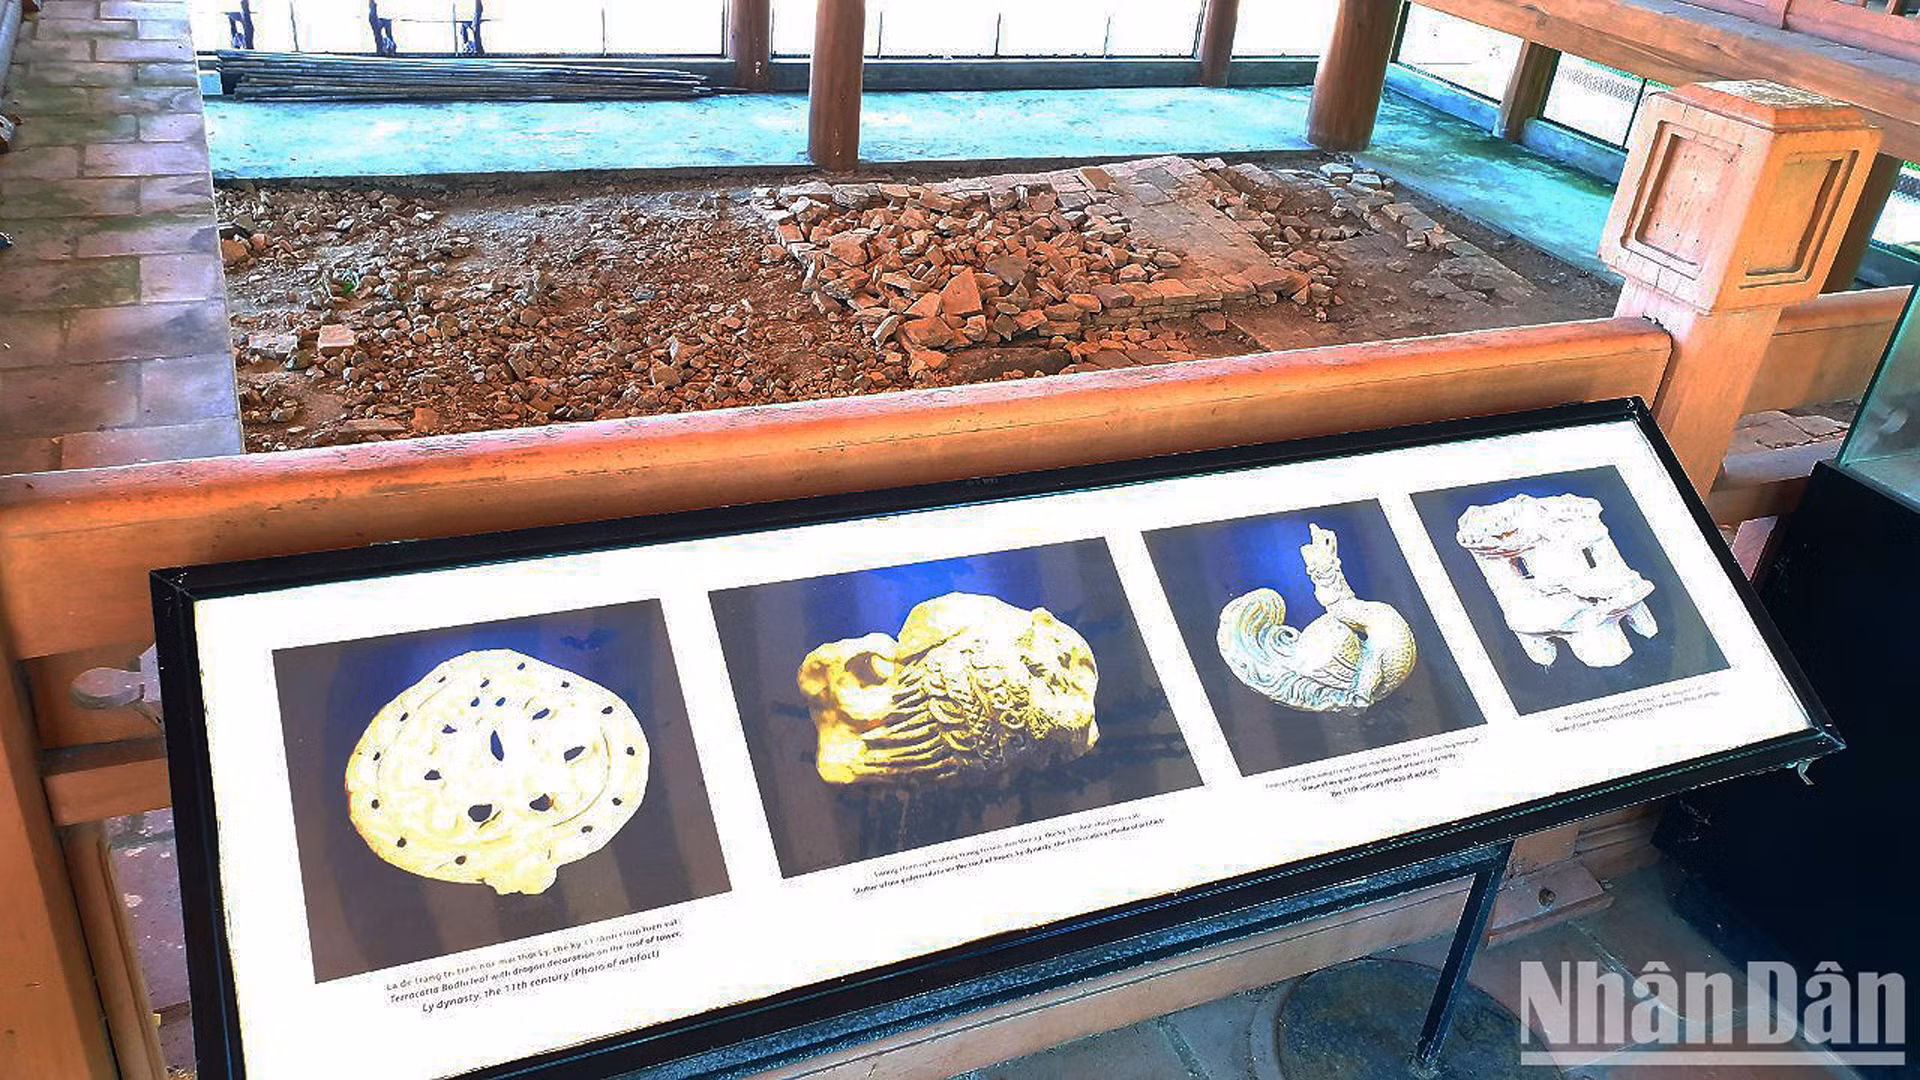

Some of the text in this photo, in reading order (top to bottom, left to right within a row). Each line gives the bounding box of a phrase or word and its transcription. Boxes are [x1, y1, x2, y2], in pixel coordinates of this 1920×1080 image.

[512, 962, 546, 976] dragon
[530, 973, 570, 987] century
[607, 958, 617, 968] of
